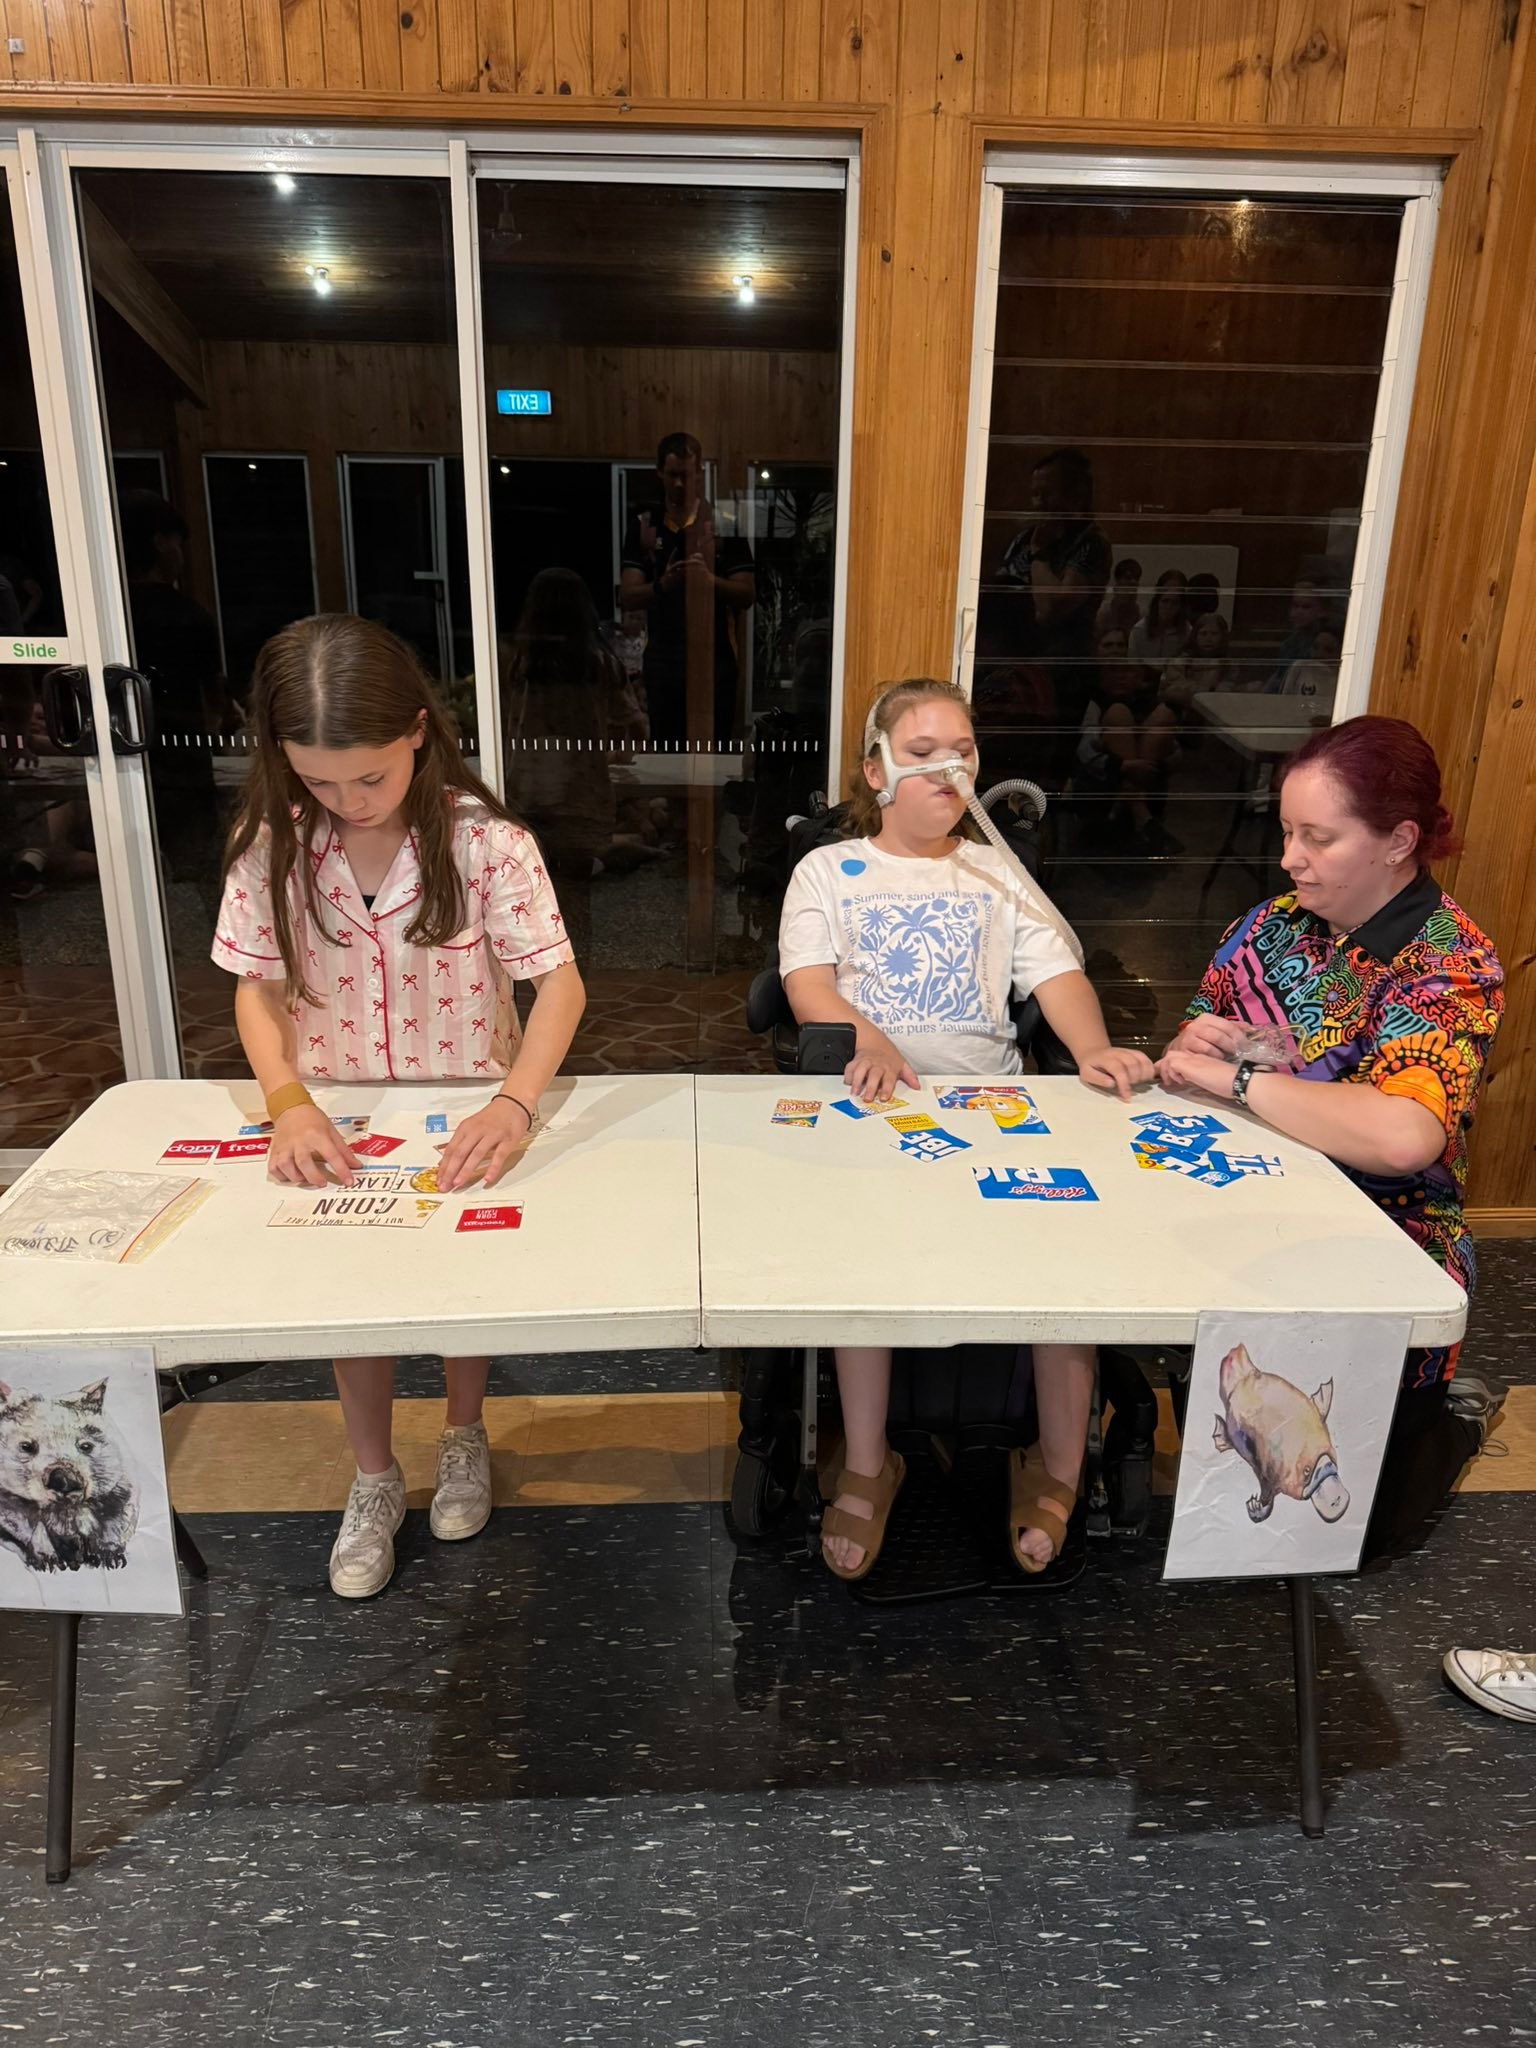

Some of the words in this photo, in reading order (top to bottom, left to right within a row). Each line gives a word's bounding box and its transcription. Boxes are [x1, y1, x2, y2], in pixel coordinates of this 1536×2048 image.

[12, 643, 57, 658] Slide
[854, 892, 904, 904] Summer,
[907, 892, 935, 901] sand
[938, 889, 960, 900] and
[962, 892, 981, 900] sea
[907, 1024, 937, 1036] sand
[228, 1142, 269, 1152] free
[338, 1177, 405, 1190] FLAK
[1008, 1183, 1088, 1198] Kellogg's
[311, 1197, 399, 1215] CORN
